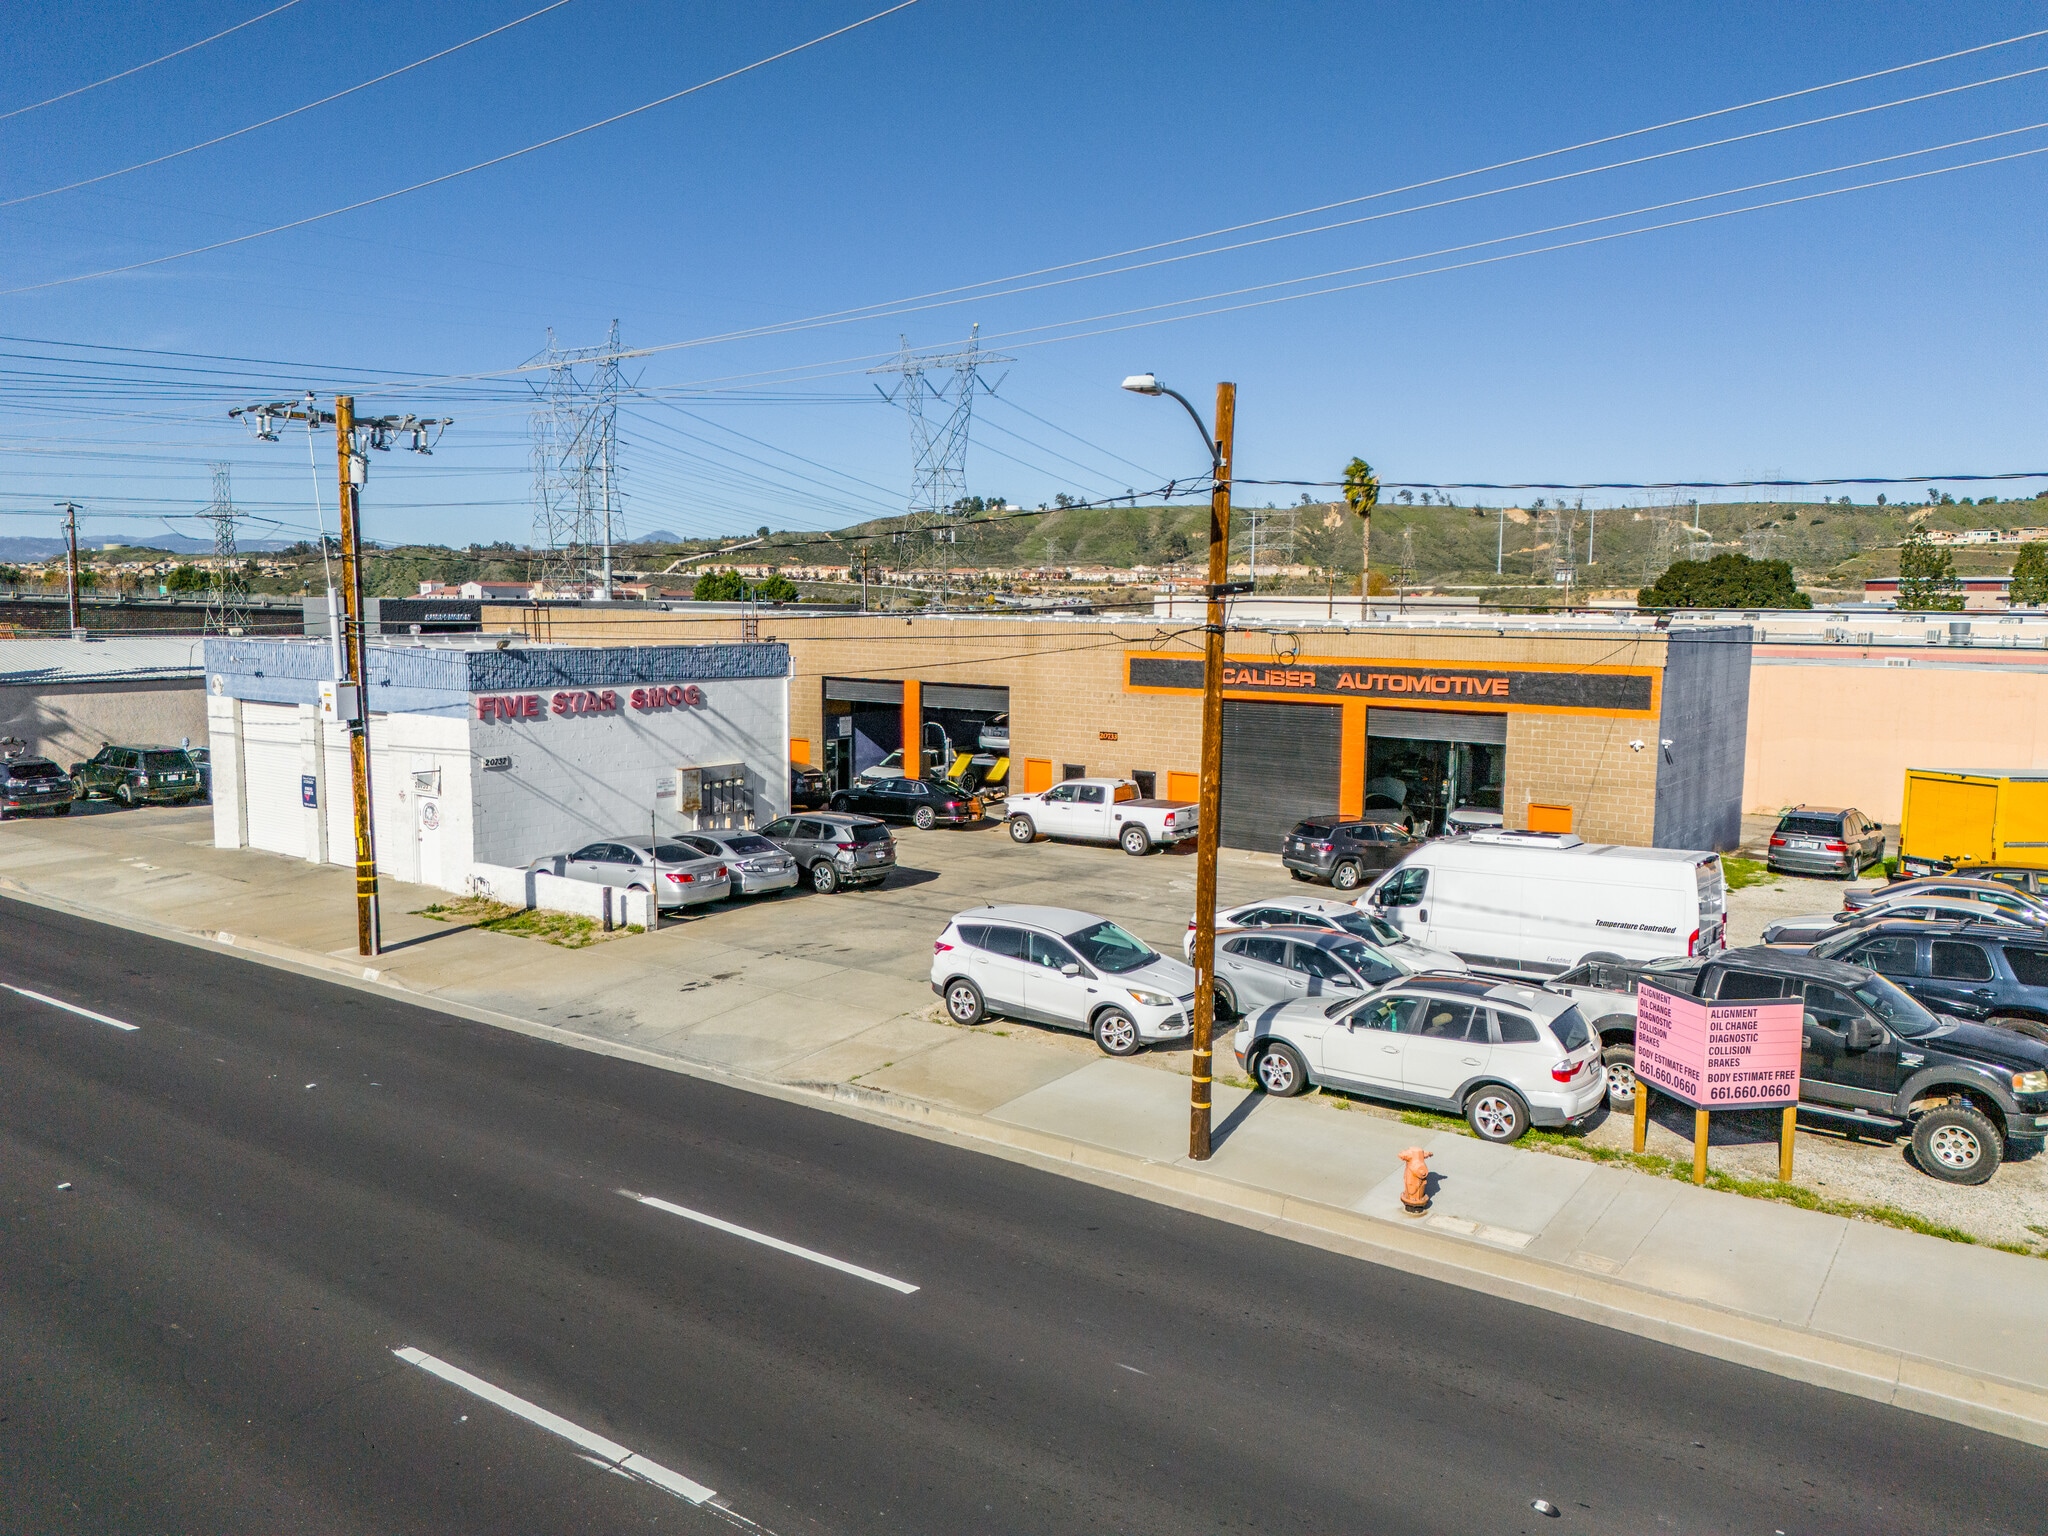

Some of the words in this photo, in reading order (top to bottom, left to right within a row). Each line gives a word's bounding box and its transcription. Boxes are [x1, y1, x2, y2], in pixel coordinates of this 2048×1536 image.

[1222, 667, 1317, 688] CALIBER
[1336, 672, 1510, 696] AUTOMOTIVE
[476, 694, 540, 720] FIVE
[551, 689, 617, 715] STAR
[629, 684, 701, 709] SMOG
[1595, 919, 1638, 930] Temperature
[1639, 923, 1677, 934] Controlled
[1640, 986, 1671, 1005] ALIGNMENT
[1640, 998, 1649, 1008] OIL
[1649, 1001, 1672, 1018] CHANGE
[1710, 1009, 1758, 1018] ALIGNMENT
[1639, 1009, 1672, 1030] DIAGNOSTIC
[1710, 1022, 1723, 1031] OIL
[1725, 1021, 1758, 1031] CHANGE
[1639, 1020, 1667, 1039] COLLISION
[1638, 1032, 1660, 1048] BRAKES
[1709, 1033, 1759, 1043] DIAGNOSTIC
[1708, 1046, 1752, 1055] COLLISION
[1638, 1046, 1654, 1059] BODY
[1654, 1053, 1683, 1074] ESTIMATE
[1684, 1066, 1700, 1081] FREE
[1708, 1058, 1740, 1067] BRAKES
[1640, 1060, 1697, 1096] 661.660.0660
[1707, 1073, 1731, 1083] BODY
[1732, 1071, 1773, 1082] ESTIMATE
[1775, 1070, 1796, 1080] FREE
[1710, 1084, 1791, 1100] 661.660.0660
